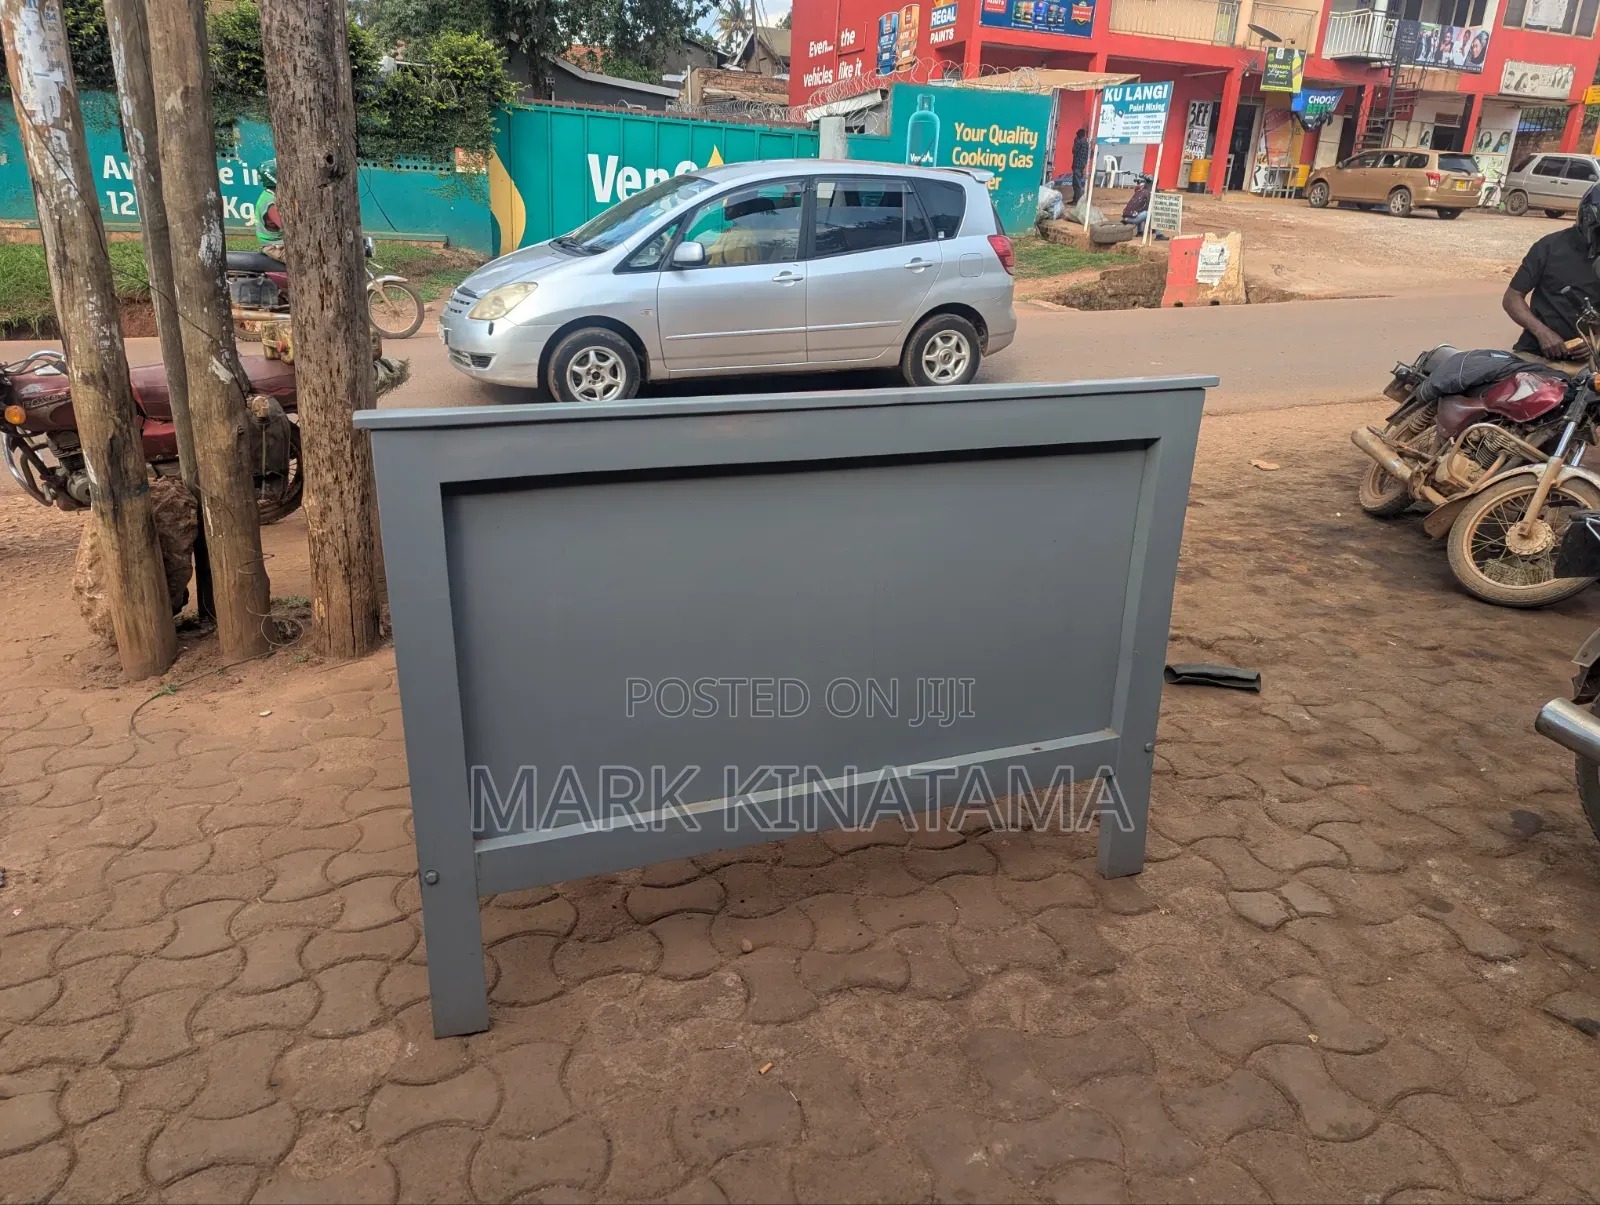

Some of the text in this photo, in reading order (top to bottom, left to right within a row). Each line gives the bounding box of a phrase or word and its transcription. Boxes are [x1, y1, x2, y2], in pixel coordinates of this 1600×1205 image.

[931, 7, 957, 26] REGAL
[840, 28, 856, 47] the
[930, 28, 955, 44] PAINTS
[803, 57, 862, 88] vehicles like it
[1104, 84, 1169, 102] KU LANGI
[1129, 102, 1166, 112] Paint Mixing
[954, 122, 1039, 150] Your Quality
[952, 147, 1034, 172] Cooking Gas
